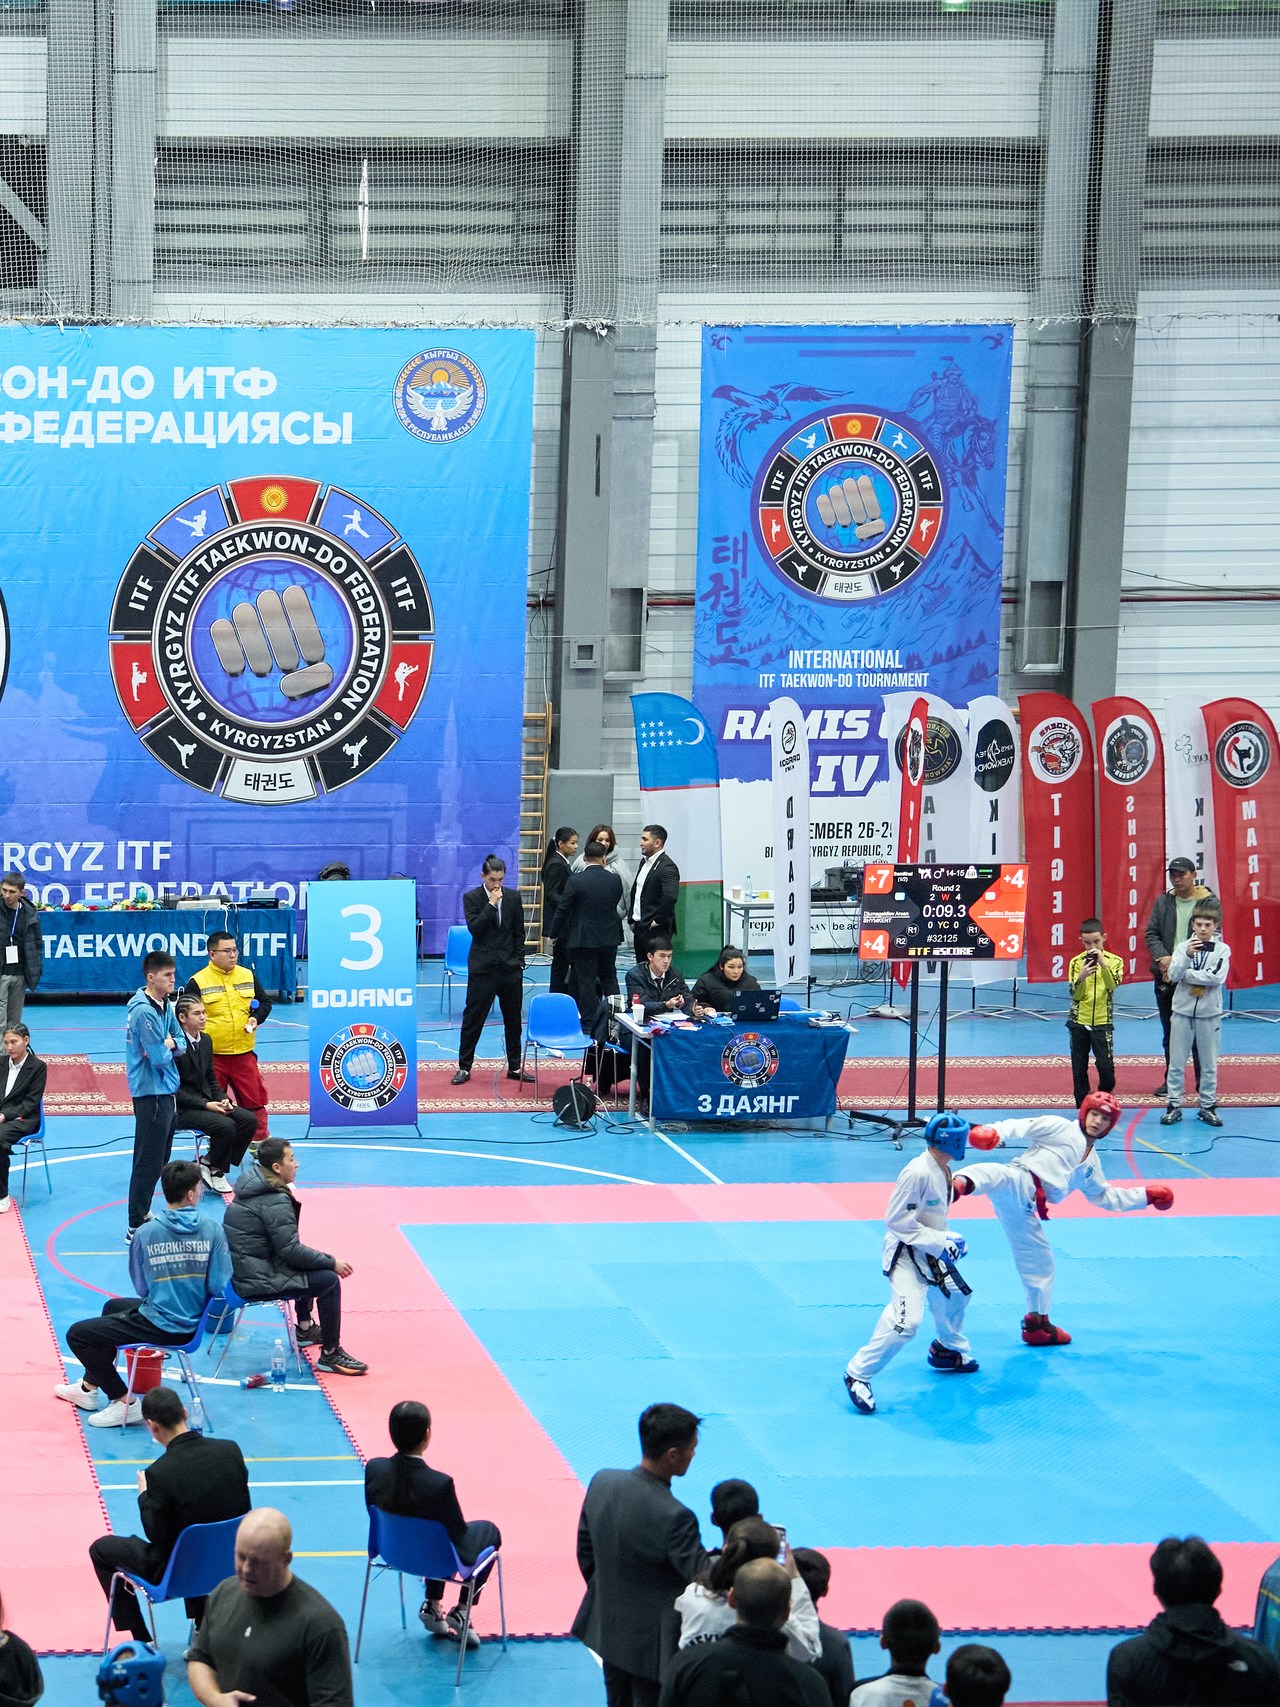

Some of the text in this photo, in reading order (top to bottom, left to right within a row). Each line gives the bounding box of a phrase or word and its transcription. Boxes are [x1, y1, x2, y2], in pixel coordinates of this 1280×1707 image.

[423, 350, 459, 361] КЫРГЫЗ
[174, 365, 277, 400] ИТФ
[408, 422, 471, 441] РЕСПУБЛИКАСЫ
[770, 469, 785, 491] ITF
[918, 469, 934, 491] ITF
[791, 444, 915, 549] KYRGYZ ITF TAEKWON-DO FEDERATION
[814, 551, 885, 570] KYRGYZSTAN
[128, 575, 156, 613] ITF
[390, 575, 417, 613] ITF
[164, 529, 382, 720] KYRGYZ ITF TAEKWON-DO FEDERATION
[788, 649, 903, 669] INTERNATIONAL
[759, 672, 929, 688] ITF TAEKWON-DO TOURNAMENT
[208, 717, 332, 750] KYRGYZSTAN
[244, 771, 296, 792] 태권도
[811, 755, 880, 792] IV
[810, 822, 853, 839] EMBER
[118, 840, 172, 870] ITF
[810, 845, 839, 857] YRGYZ
[841, 845, 884, 857] REPUBLIC,
[869, 869, 890, 888] +7
[932, 884, 960, 892] Round 2
[1003, 869, 1024, 888] +4
[930, 893, 961, 901] 2 W 4
[922, 904, 966, 918] 0:09.3
[742, 920, 774, 931] repp
[927, 921, 959, 929] 0 YC 0
[41, 933, 208, 958] TAEKWOND
[243, 933, 286, 957] ITF
[340, 904, 384, 971] 3
[864, 935, 885, 953] +4
[927, 935, 958, 943] #32125
[999, 934, 1019, 953] +3
[312, 988, 413, 1009] DOJANG
[698, 1094, 799, 1116] 3 ДАЯНГ
[146, 1240, 210, 1257] KAZAKHSTAN
